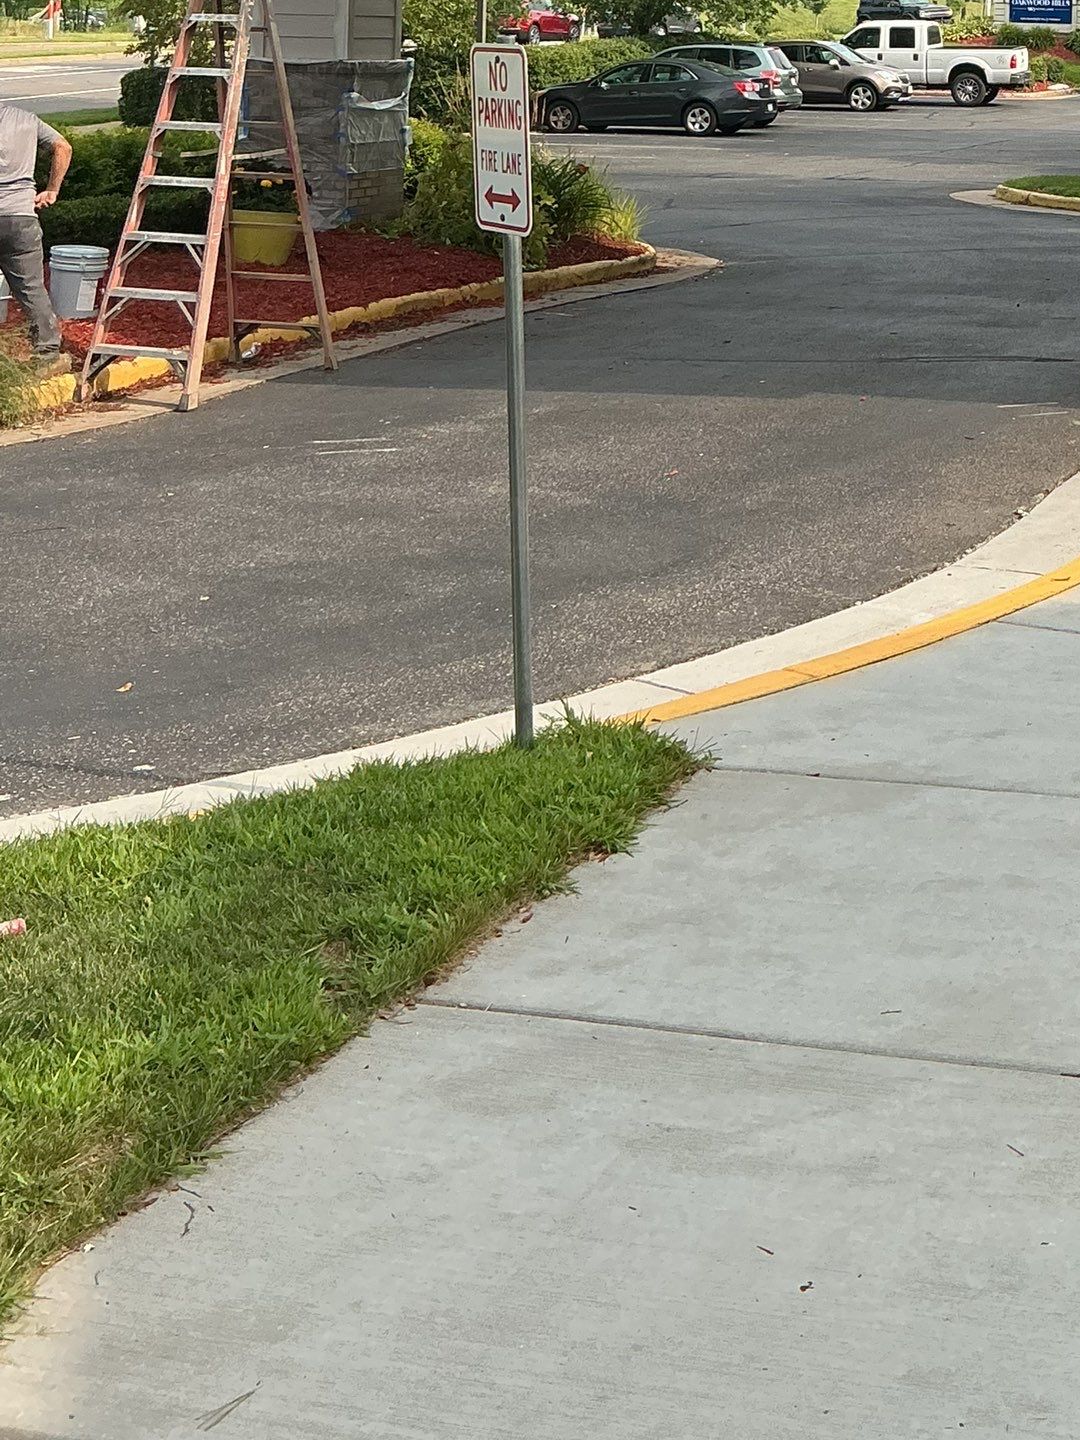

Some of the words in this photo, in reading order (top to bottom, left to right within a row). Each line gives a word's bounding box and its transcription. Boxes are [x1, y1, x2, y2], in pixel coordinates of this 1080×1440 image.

[489, 61, 508, 92] NO
[477, 97, 522, 130] PARKING
[480, 149, 498, 172] FIRE
[501, 152, 522, 176] LANE
